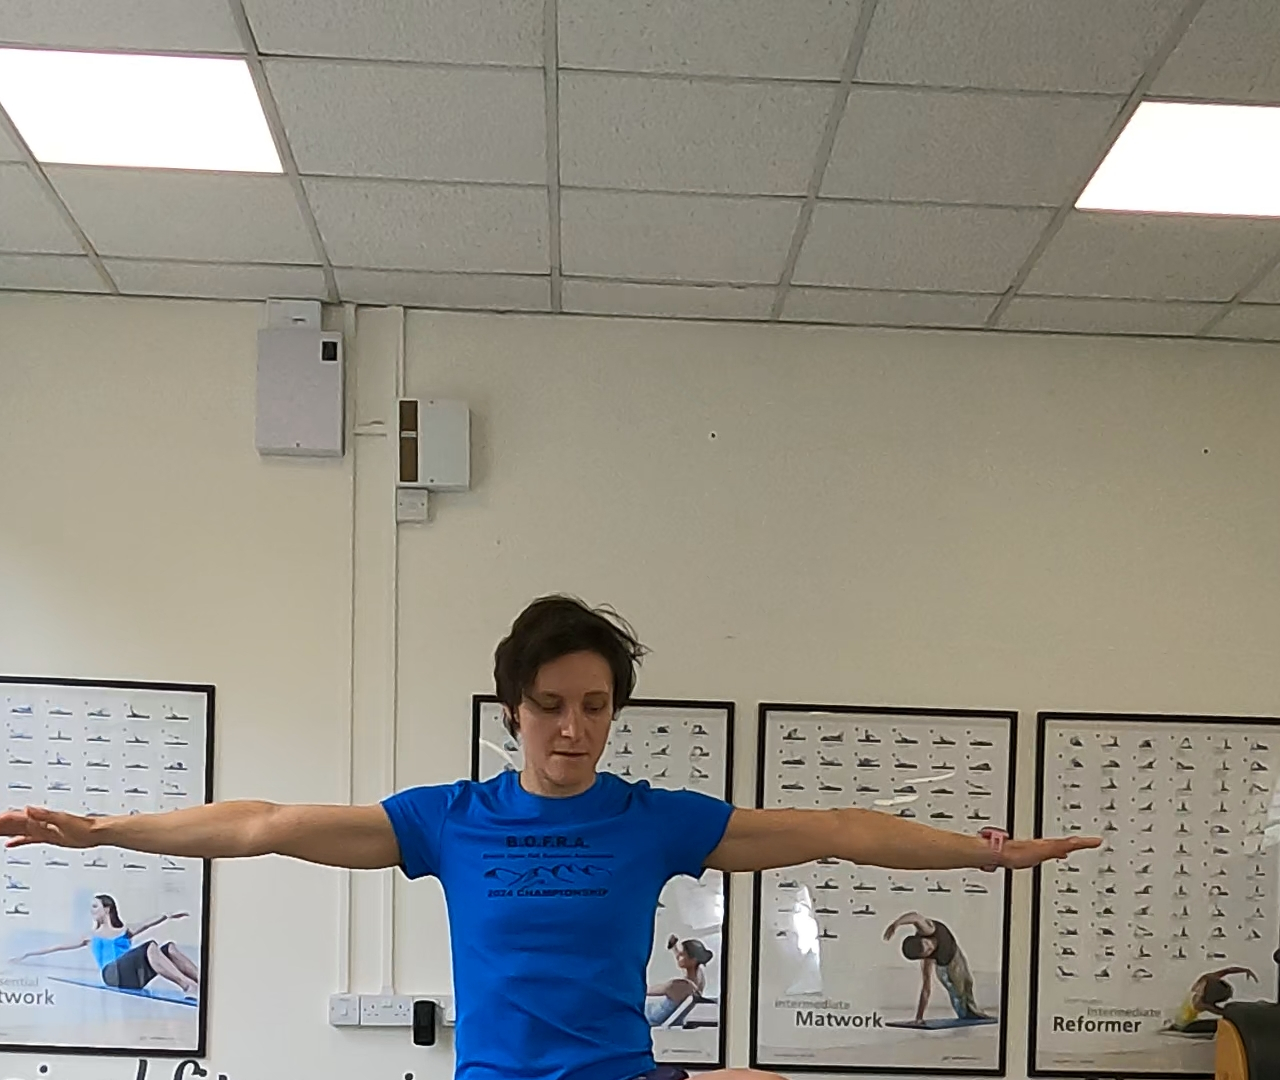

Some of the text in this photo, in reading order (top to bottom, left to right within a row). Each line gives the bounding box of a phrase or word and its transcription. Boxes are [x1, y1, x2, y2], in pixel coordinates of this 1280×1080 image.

[516, 888, 609, 898] CHAMPIONSHIP
[795, 1010, 883, 1028] Matwork
[1052, 1015, 1142, 1033] Reformer
